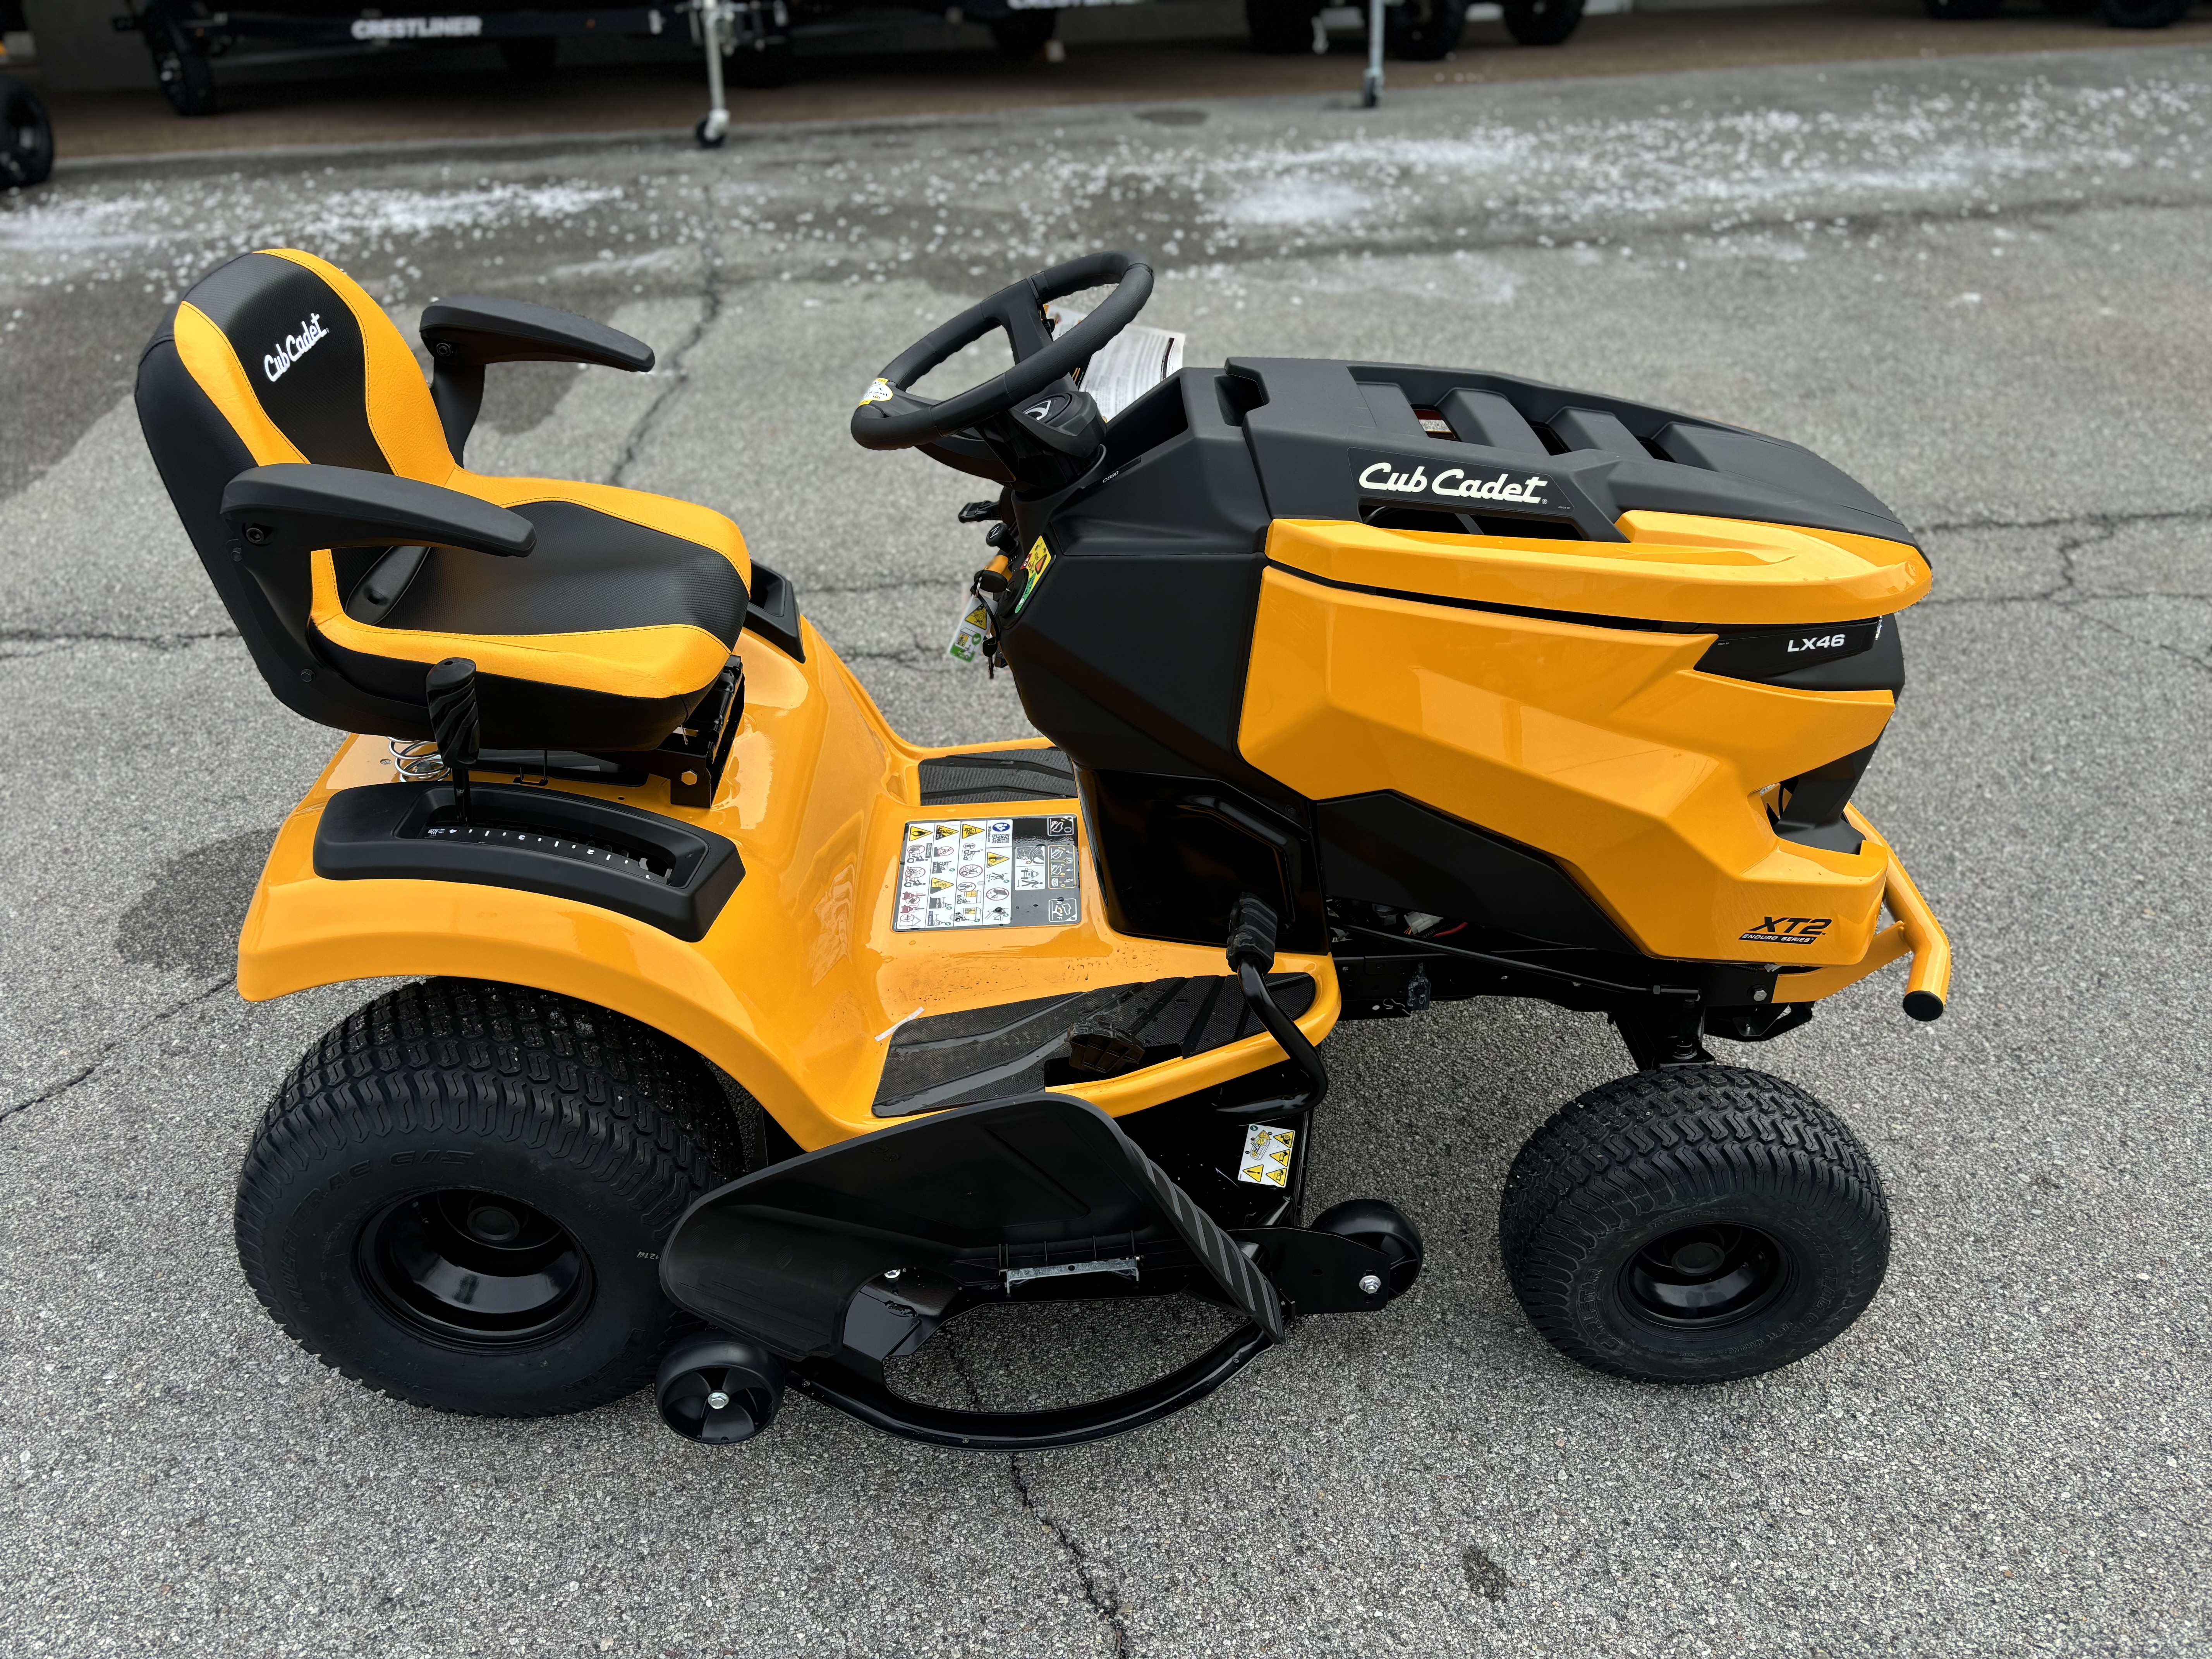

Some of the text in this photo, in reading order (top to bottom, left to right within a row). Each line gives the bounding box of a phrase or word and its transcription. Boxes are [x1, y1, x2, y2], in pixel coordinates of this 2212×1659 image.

[350, 15, 482, 39] CRESTLINER
[264, 313, 327, 382] Cub Cadet
[1359, 462, 1548, 504] Cub Cadet
[1787, 634, 1845, 652] LX46
[1748, 916, 1832, 935] XT2
